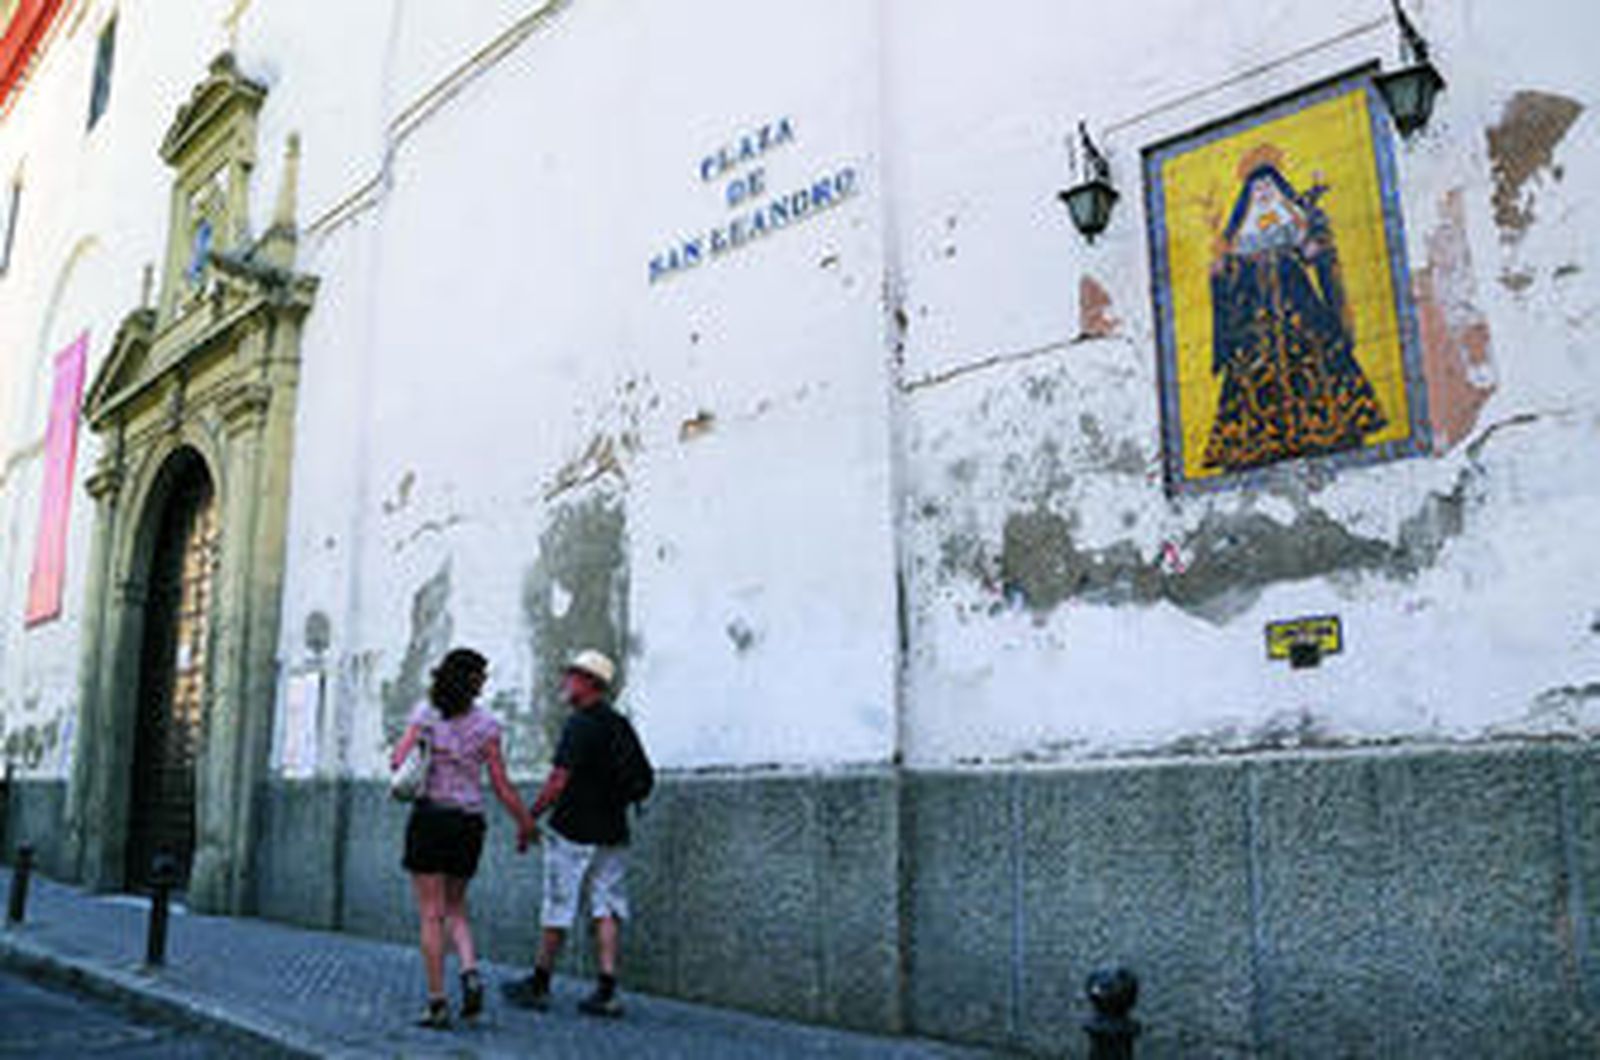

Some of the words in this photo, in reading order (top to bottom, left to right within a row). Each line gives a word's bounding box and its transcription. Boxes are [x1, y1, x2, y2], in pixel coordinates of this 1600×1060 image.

[700, 118, 794, 181] PLAZA
[726, 168, 765, 206] DE
[649, 239, 701, 284] SAN
[710, 168, 857, 254] LEANDRO
